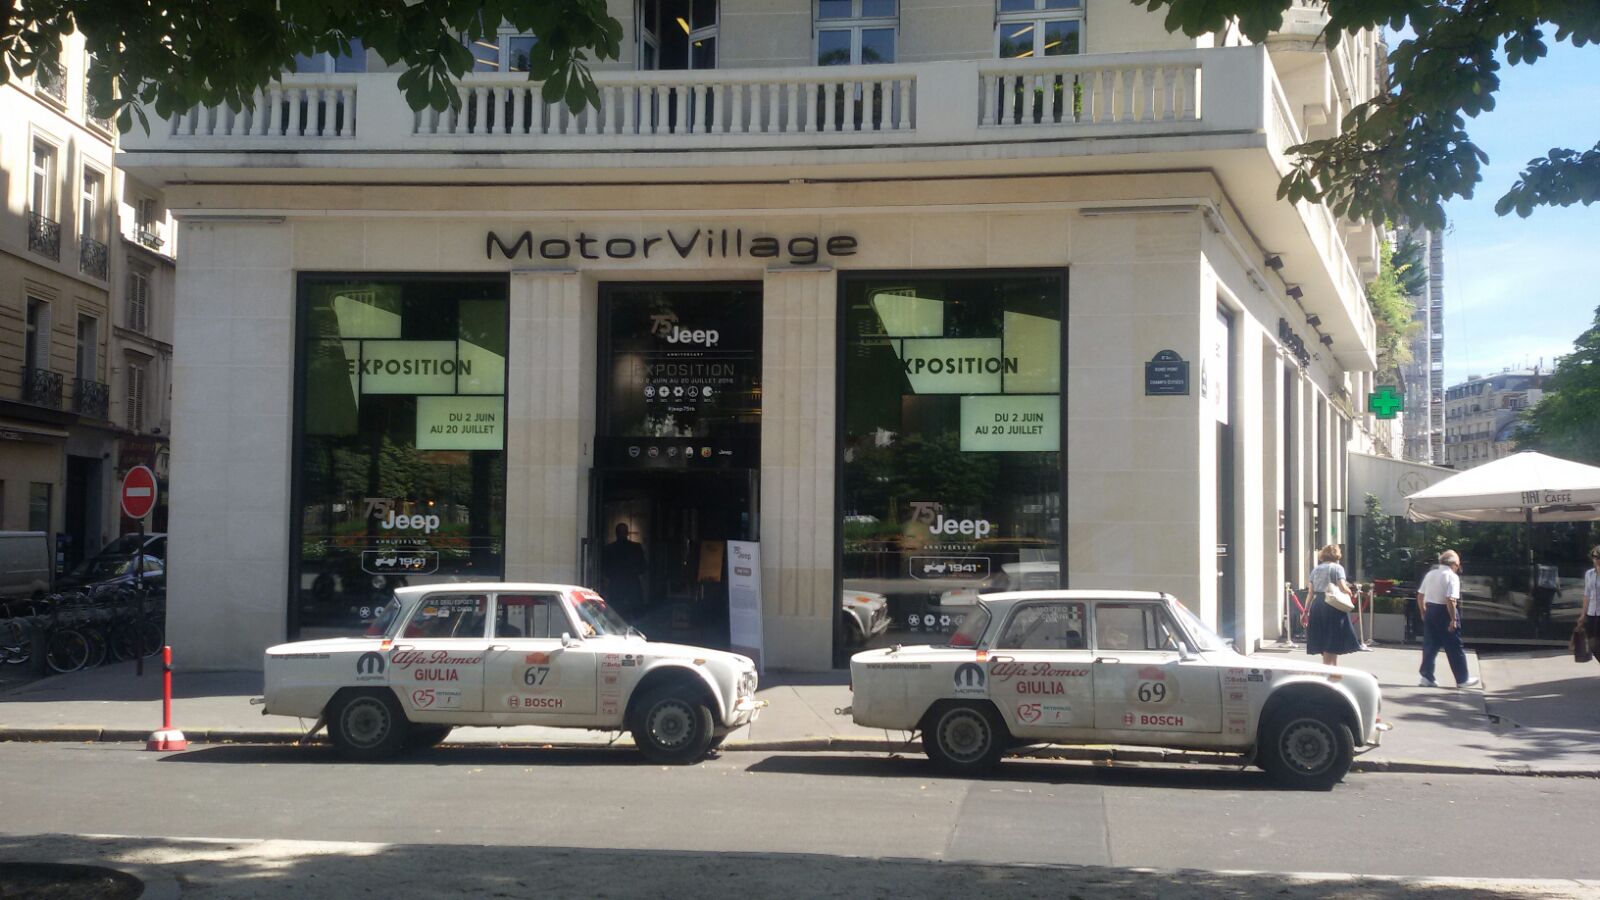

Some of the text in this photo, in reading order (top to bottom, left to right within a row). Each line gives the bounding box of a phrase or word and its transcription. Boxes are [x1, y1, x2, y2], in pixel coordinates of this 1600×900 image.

[486, 228, 858, 265] MotorVillage
[667, 325, 719, 347] Jeep
[449, 413, 495, 422] DU 2 JUIN
[994, 413, 1044, 422] DU 2 JUIN
[430, 425, 495, 434] AU 20 JUILLET
[975, 425, 1043, 435] AU 20 JUILLET
[382, 510, 440, 534] Jeep
[929, 514, 991, 539] Jeep
[948, 563, 977, 573] 1941
[391, 650, 482, 670] Alfa Romeo
[414, 669, 459, 681] GIULIA
[524, 666, 550, 686] 67
[989, 662, 1090, 682] Alfa Romeo
[1016, 681, 1065, 695] GIULIA
[1137, 682, 1166, 703] 69
[524, 698, 563, 708] BOSCH
[1140, 715, 1184, 726] BOSCH
